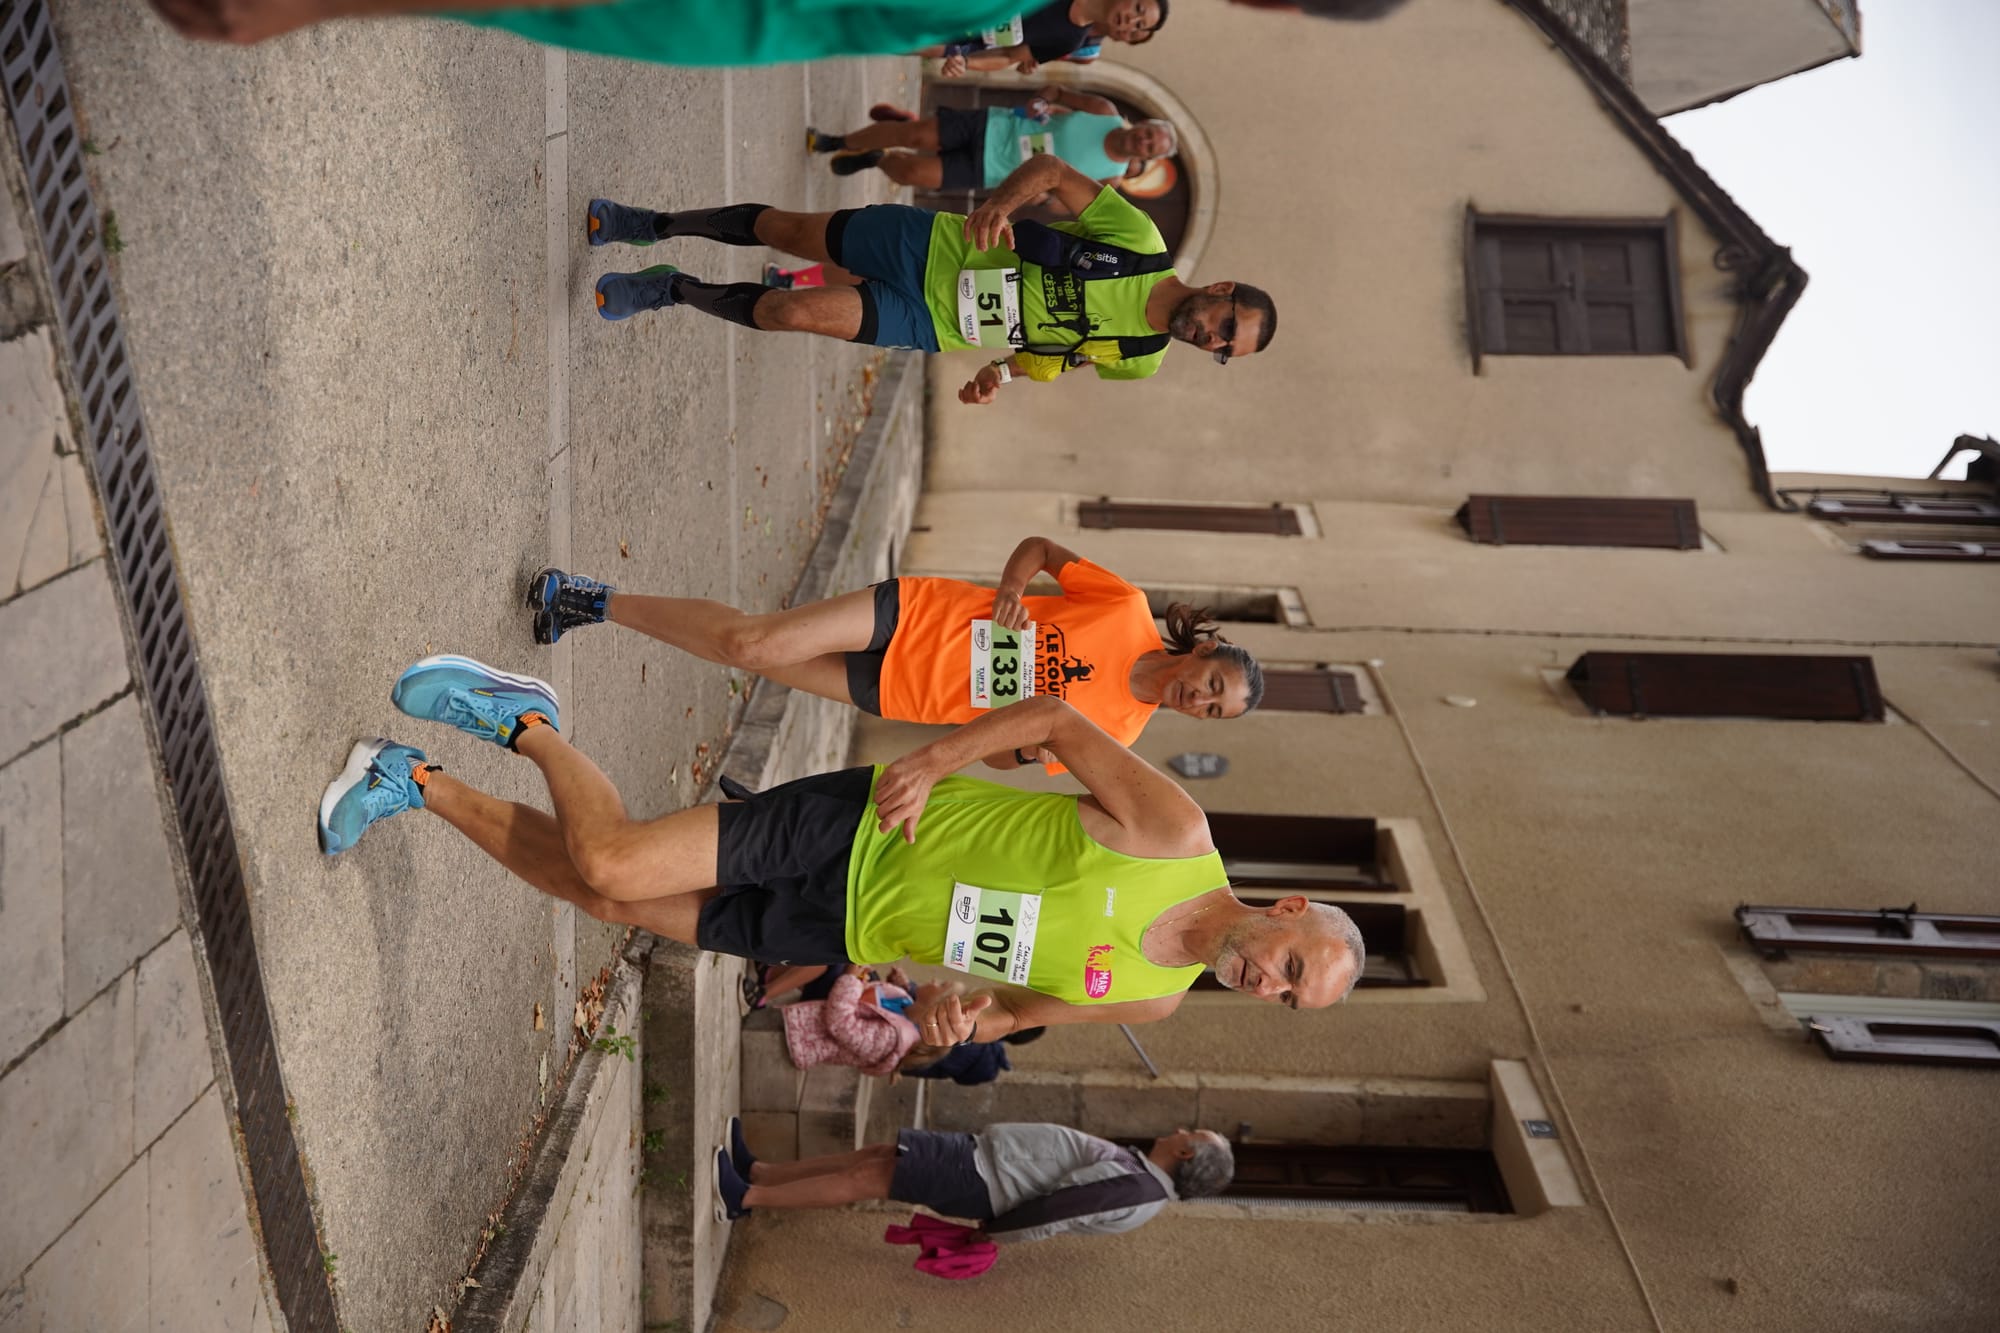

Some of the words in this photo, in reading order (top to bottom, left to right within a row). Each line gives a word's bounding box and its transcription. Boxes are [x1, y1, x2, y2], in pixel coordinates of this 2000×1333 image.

[1063, 273, 1077, 303] TRAIL
[978, 292, 1004, 327] 51
[1046, 633, 1059, 653] LE
[993, 634, 1018, 697] 133
[1047, 656, 1060, 698] COU
[962, 896, 972, 920] BFP
[973, 908, 1014, 973] 107
[1095, 972, 1110, 995] MARC
